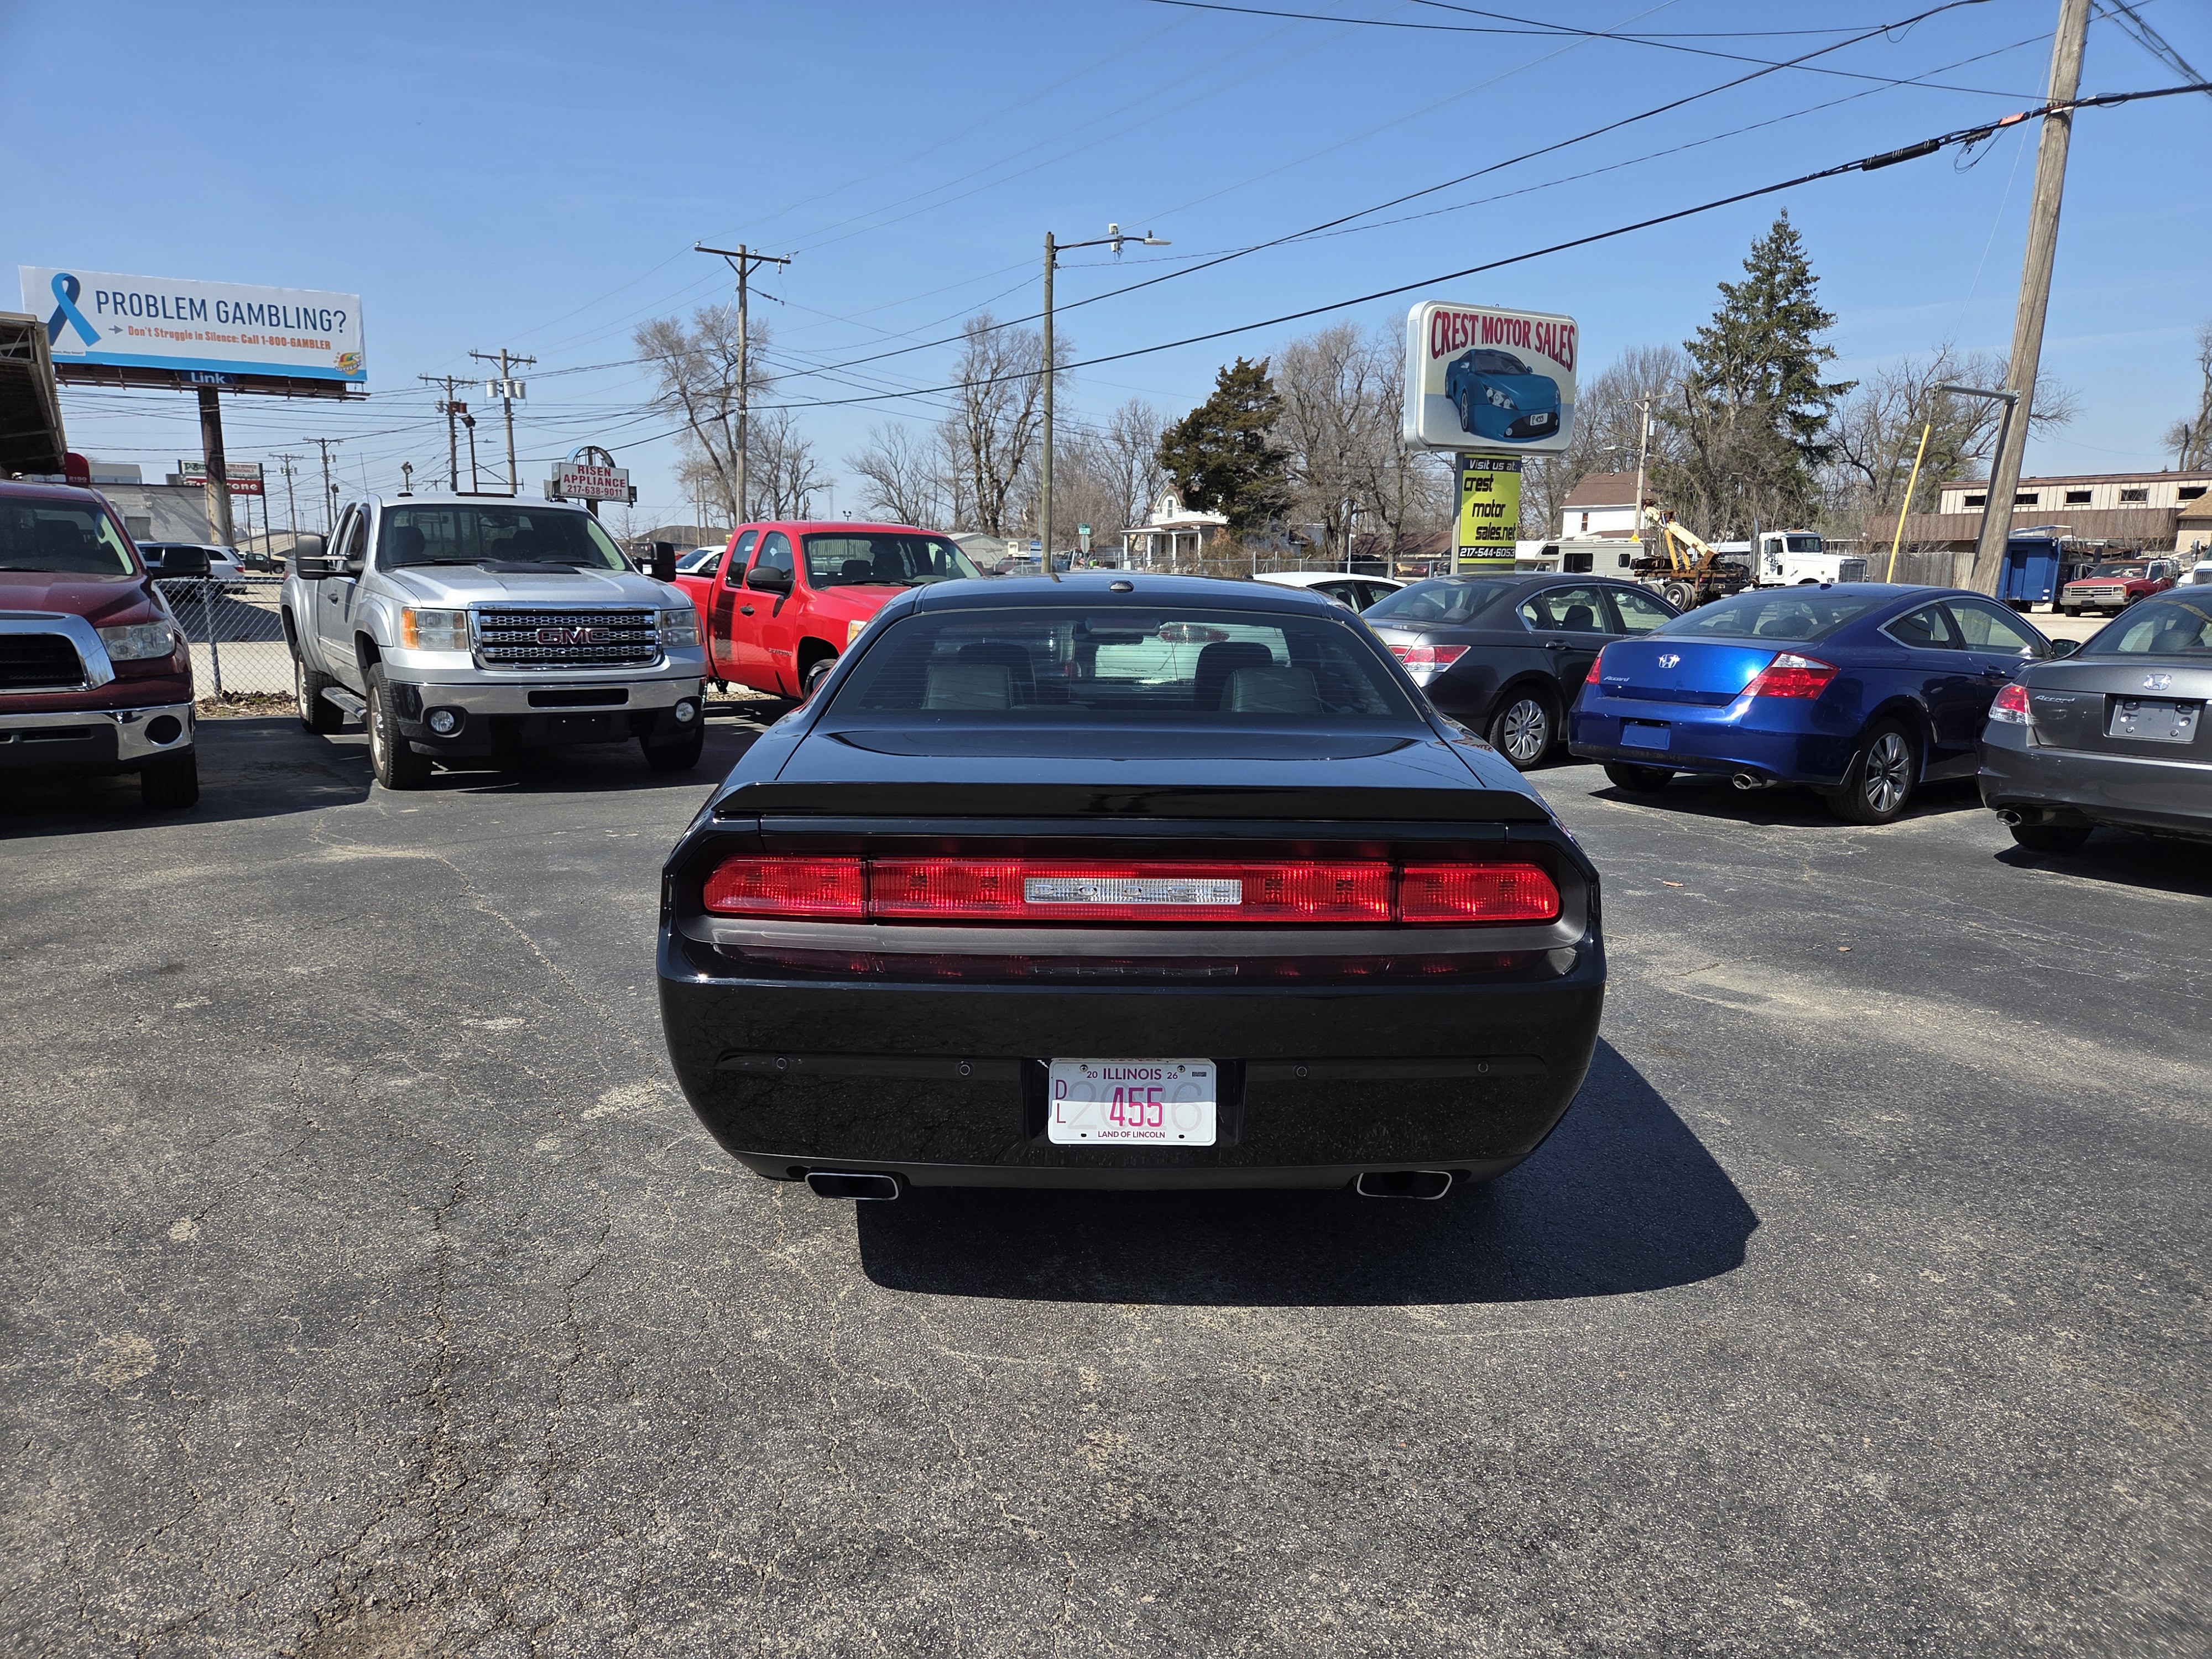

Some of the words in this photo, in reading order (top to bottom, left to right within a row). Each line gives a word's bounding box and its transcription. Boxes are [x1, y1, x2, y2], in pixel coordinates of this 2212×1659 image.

[96, 290, 207, 322] PROBLEM
[216, 300, 346, 333] GAMBLING?
[128, 325, 152, 337] Don't
[154, 327, 192, 341] Struggle
[205, 331, 239, 343] Silence:
[241, 334, 259, 345] Call
[261, 335, 331, 350] 1-800-GAMBLER
[1431, 310, 1479, 359] CREST
[1481, 316, 1531, 349] MOTOR
[1535, 321, 1575, 372] SALES
[191, 372, 226, 384] Link
[578, 465, 611, 477] RISEN
[1470, 459, 1490, 469] Visit
[1493, 462, 1505, 470] us
[1506, 461, 1517, 471] at:
[564, 474, 626, 488] APPLIANCE
[1464, 473, 1494, 492] crest
[567, 484, 622, 497] 217-638-9011
[1472, 499, 1506, 518] motor
[1475, 522, 1516, 541] sales.net
[1460, 547, 1515, 557] 217-544-6053
[537, 627, 609, 644] GMC
[1086, 1071, 1098, 1079] 20
[1103, 1068, 1162, 1080] ILLINOIS
[1109, 1087, 1163, 1127] 455
